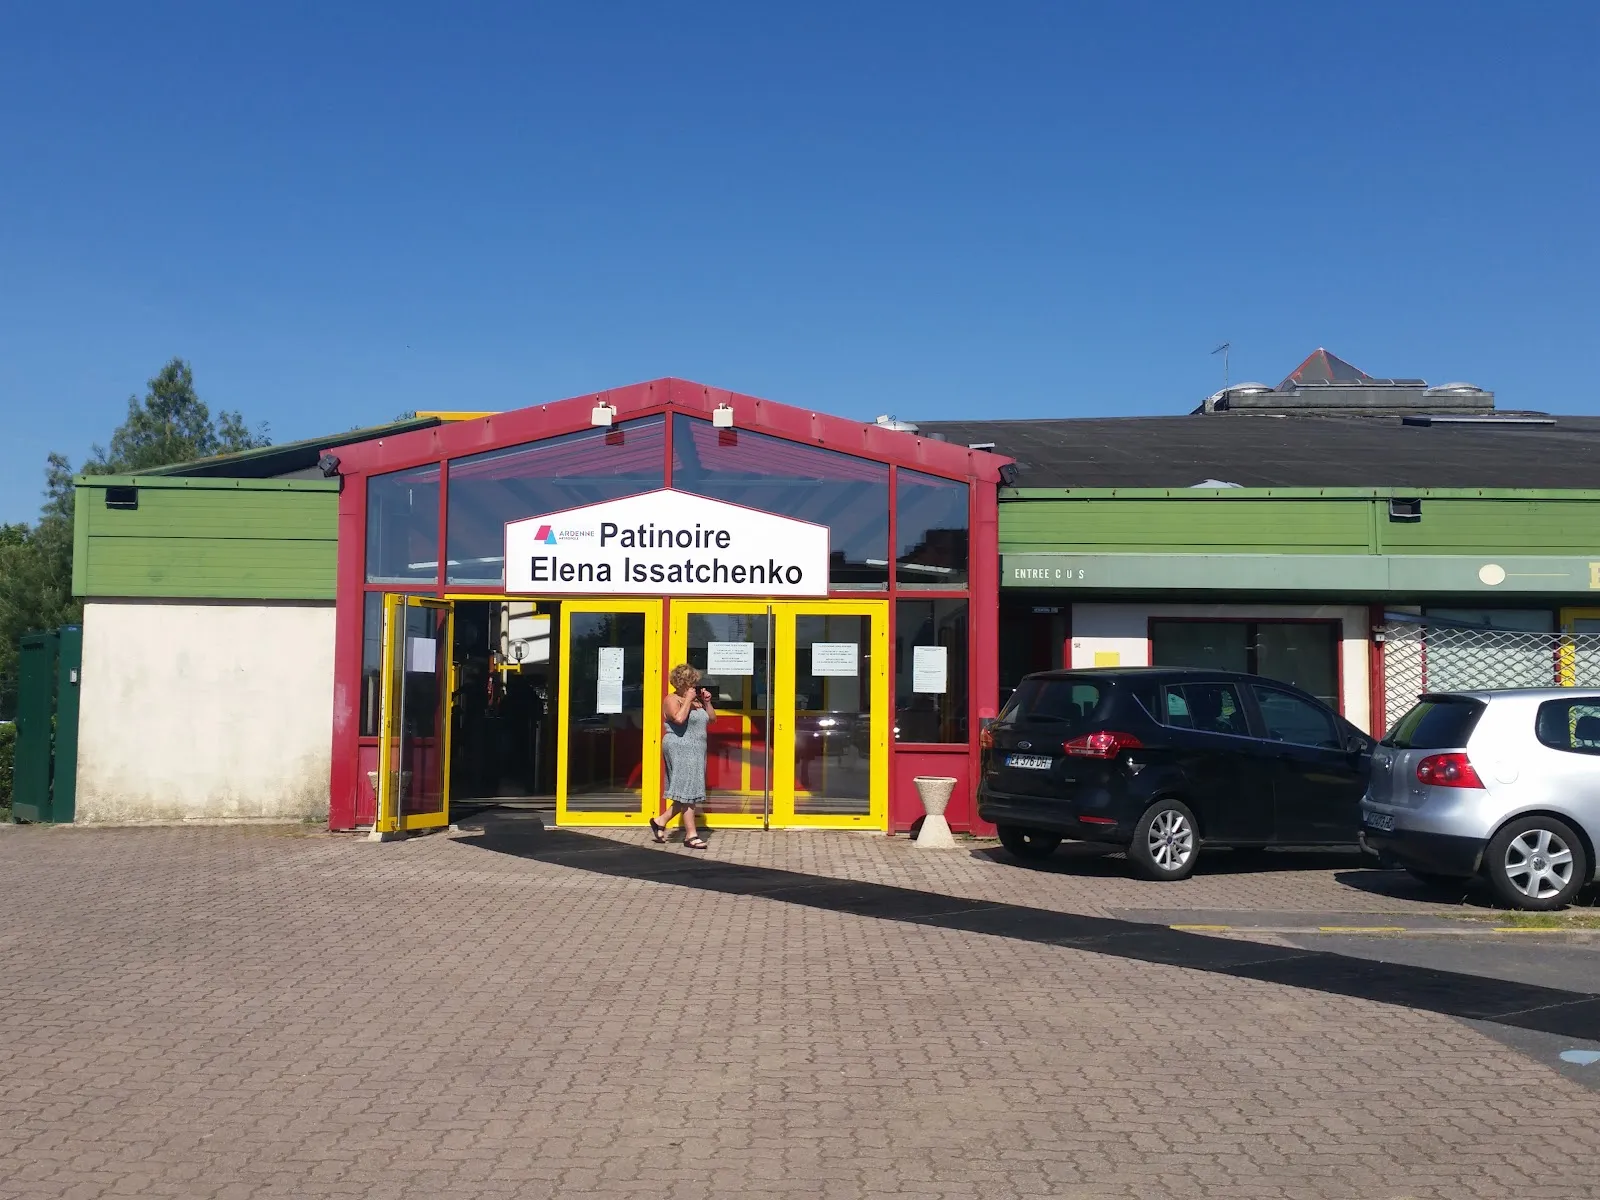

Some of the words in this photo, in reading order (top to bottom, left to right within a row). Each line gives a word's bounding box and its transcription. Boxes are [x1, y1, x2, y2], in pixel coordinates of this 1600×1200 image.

[600, 522, 731, 549] Patinoire
[531, 556, 612, 582] Elena
[624, 557, 803, 585] Issatchenko
[1015, 568, 1050, 579] ENTREE
